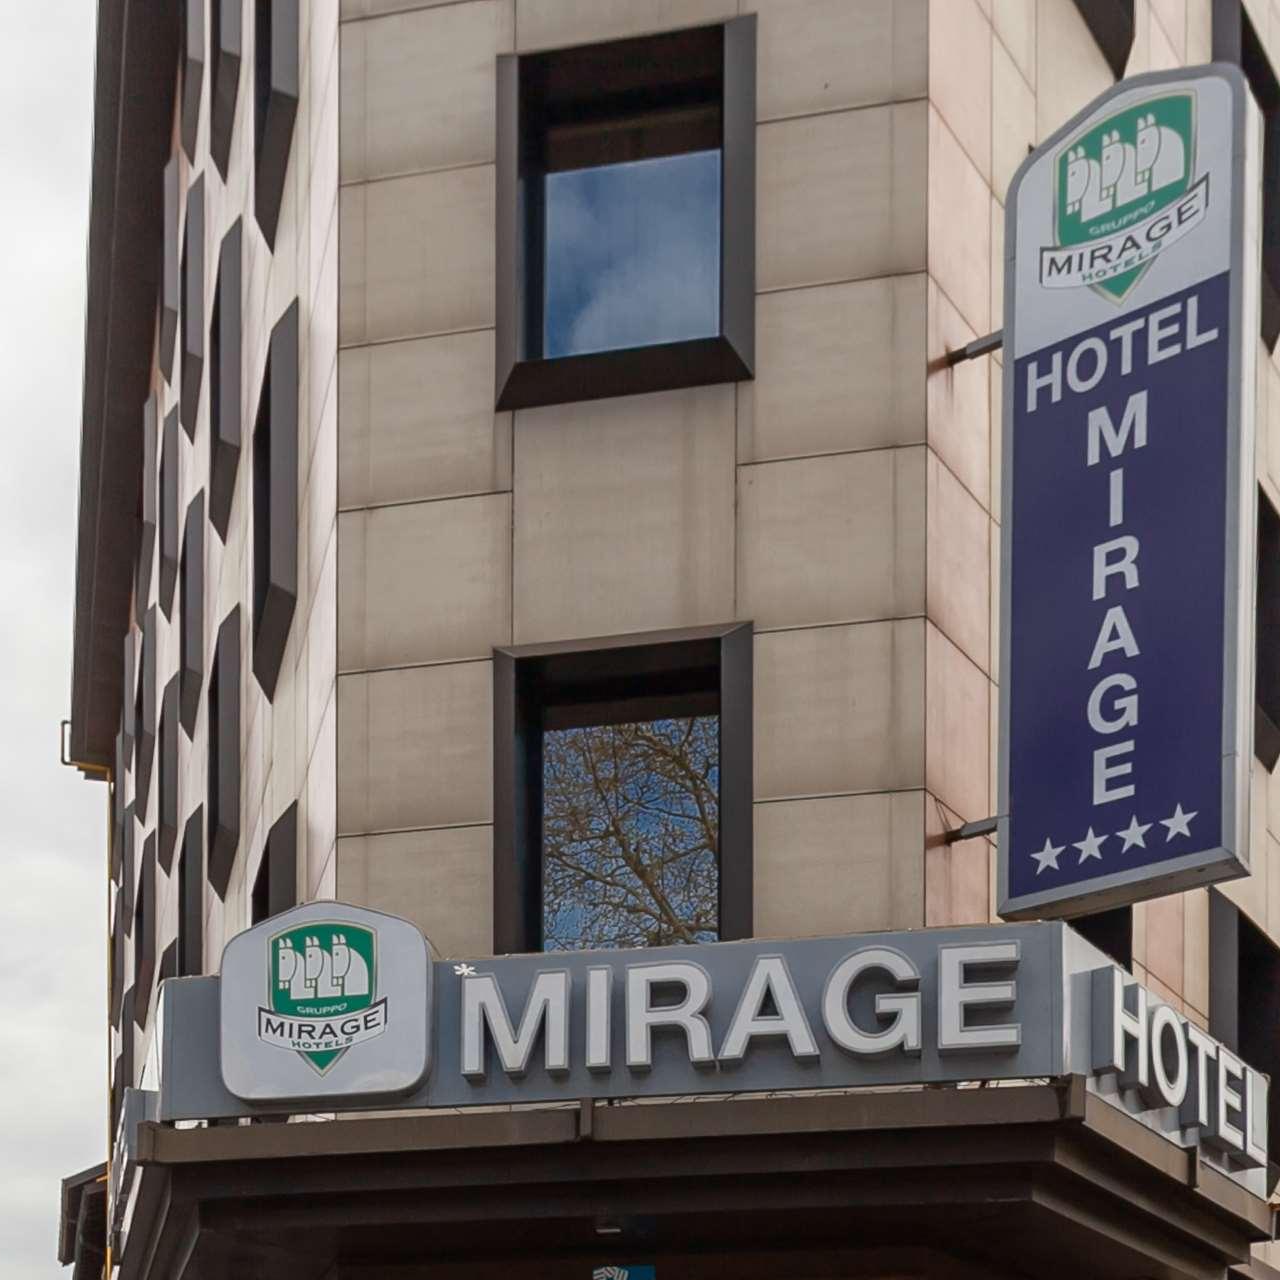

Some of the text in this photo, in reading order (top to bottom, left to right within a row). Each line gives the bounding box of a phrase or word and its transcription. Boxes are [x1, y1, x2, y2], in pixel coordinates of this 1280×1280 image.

[1047, 192, 1200, 278] MIRAGE
[1088, 200, 1156, 236] GRUPPO
[1081, 241, 1163, 284] HOTELS
[1026, 294, 1219, 413] HOTEL
[1087, 389, 1149, 806] MIRAGE
[264, 1009, 381, 1040] MIRAGE
[296, 1002, 348, 1016] GRUPPO
[460, 940, 1021, 1077] MIRAGE
[291, 1036, 354, 1050] HOTELS
[1112, 965, 1268, 1168] HOTEL
